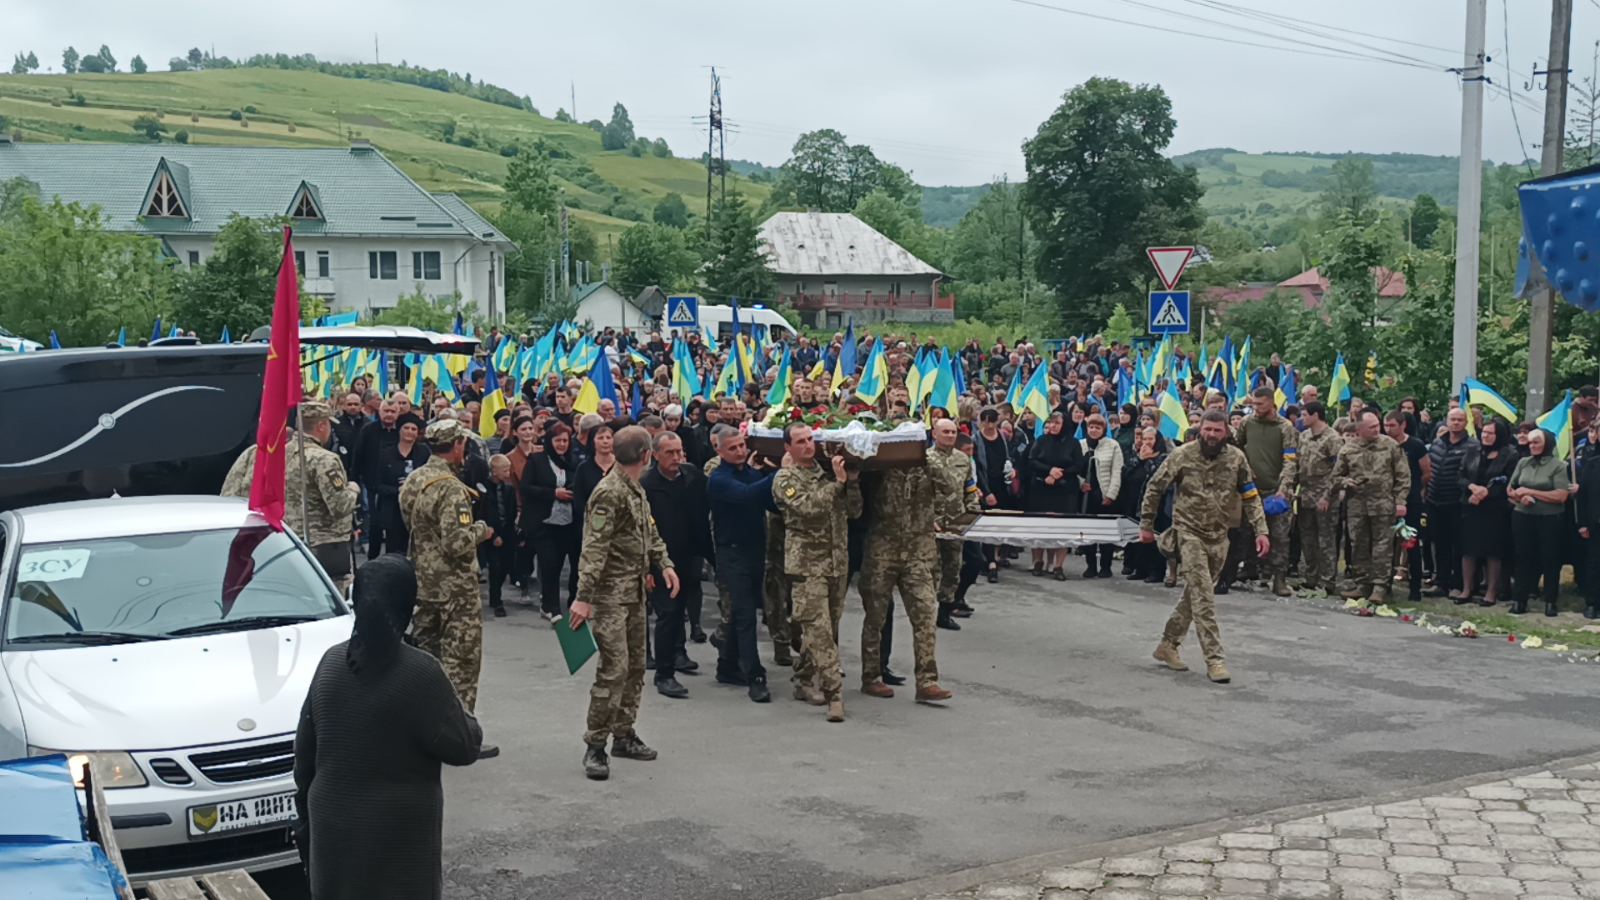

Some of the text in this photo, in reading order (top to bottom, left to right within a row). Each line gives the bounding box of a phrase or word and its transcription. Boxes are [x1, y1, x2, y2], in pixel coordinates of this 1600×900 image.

[23, 559, 82, 574] ЗСУ
[220, 795, 295, 822] НА ЩИТ
